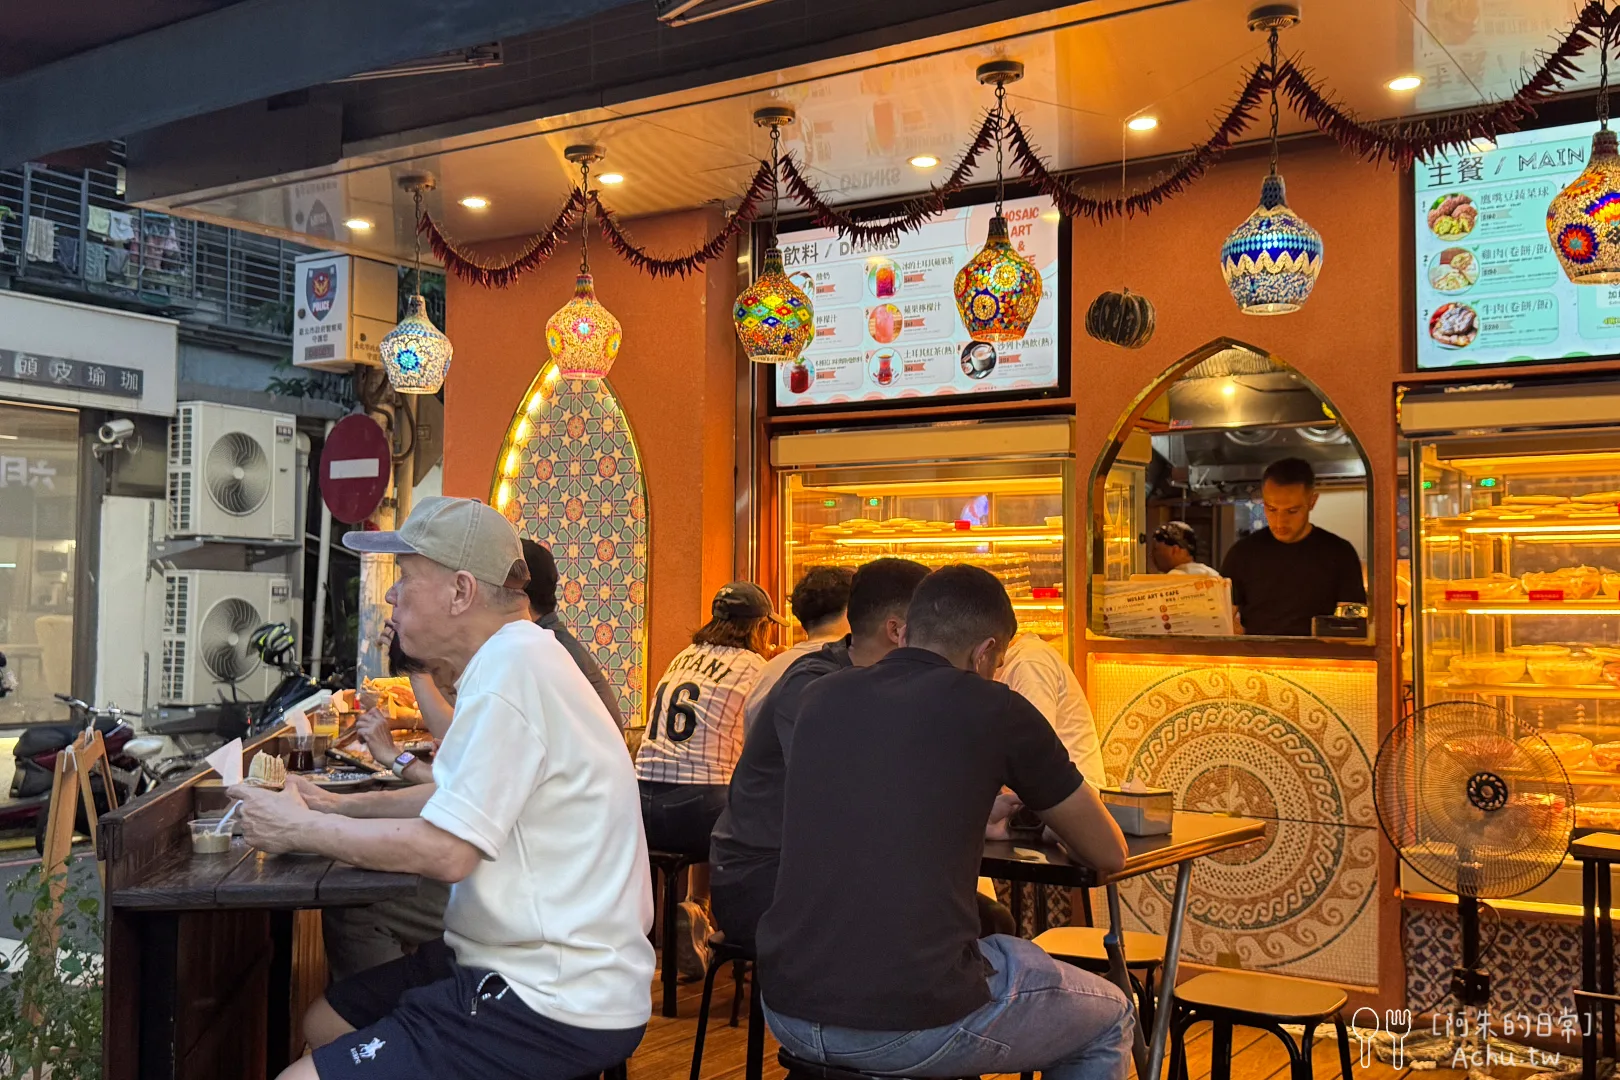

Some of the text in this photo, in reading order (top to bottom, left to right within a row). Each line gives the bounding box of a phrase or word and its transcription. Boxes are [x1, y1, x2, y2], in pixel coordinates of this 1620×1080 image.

[1428, 156, 1484, 187] 主餐
[1518, 146, 1585, 171] MAIN
[1010, 224, 1033, 238] ART
[783, 242, 819, 267] 飲料
[1017, 240, 1025, 252] &
[312, 300, 330, 311] POLICE
[0, 354, 138, 391] 頭皮瑜珈
[648, 681, 700, 742] 16
